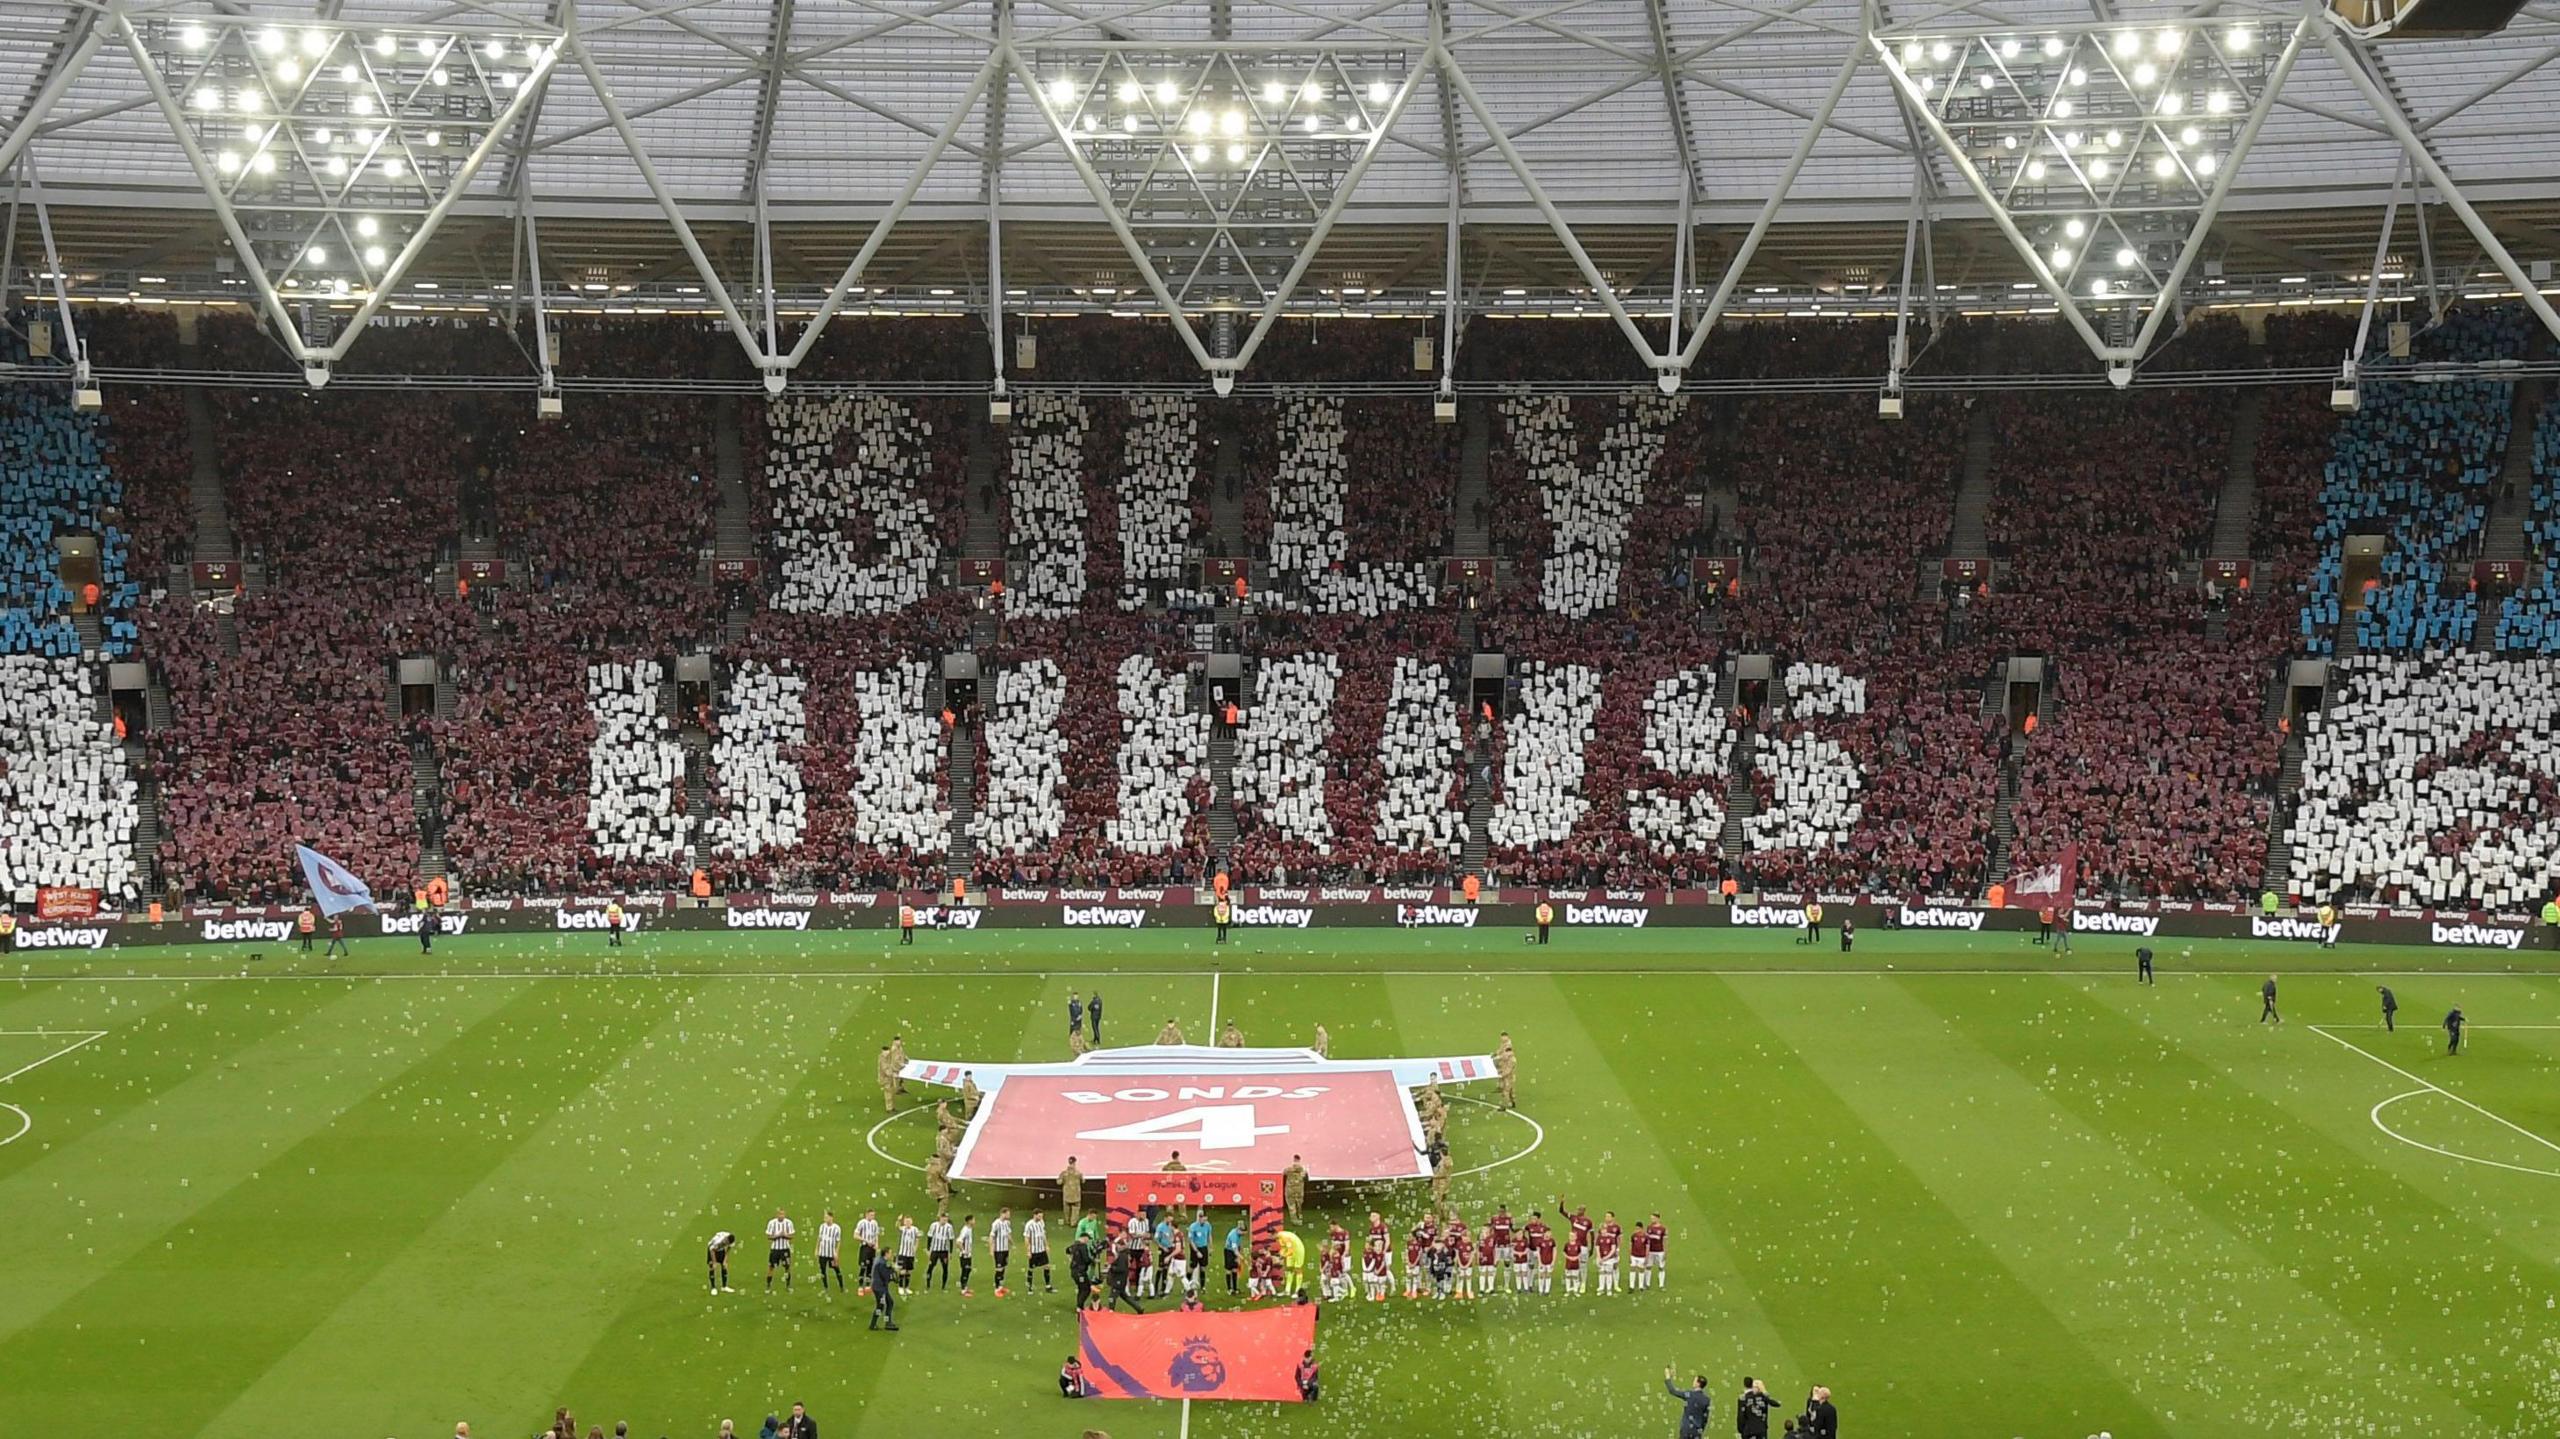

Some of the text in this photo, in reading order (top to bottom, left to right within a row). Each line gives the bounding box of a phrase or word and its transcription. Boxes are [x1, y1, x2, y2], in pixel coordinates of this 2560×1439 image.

[207, 564, 226, 573] 240
[472, 562, 490, 571] 239
[727, 561, 744, 570] 238
[974, 561, 991, 570] 237
[1218, 560, 1235, 569] 236
[1462, 560, 1479, 569] 235
[1707, 561, 1725, 569] 234
[1958, 561, 1976, 570] 233
[2218, 562, 2236, 571] 232
[2491, 562, 2510, 572] 231
[625, 895, 665, 906] betway
[771, 893, 818, 905] betway
[830, 892, 877, 905] betway
[1002, 888, 1049, 902] betway
[1060, 889, 1107, 902] betway
[1118, 889, 1164, 902] betway
[1259, 888, 1309, 902] betway
[1321, 888, 1371, 902] betway
[1383, 888, 1433, 902] betway
[1549, 890, 1588, 902] betway
[1763, 892, 1803, 904] betway
[1817, 893, 1857, 905] betway
[472, 899, 512, 910] betway
[523, 898, 565, 910] betway
[1924, 896, 1965, 907] betway
[2074, 899, 2106, 909] betway
[2160, 902, 2193, 912] betway
[2204, 903, 2236, 912] betway
[192, 907, 223, 917] betway
[236, 905, 266, 916] betway
[1063, 905, 1145, 928] betway
[1231, 904, 1312, 928] betway
[1566, 904, 1648, 928] betway
[2344, 907, 2378, 918] betway
[2389, 908, 2423, 919] betway
[2435, 910, 2469, 921] betway
[727, 907, 810, 930] betway
[1900, 905, 1985, 931] betway
[2073, 910, 2159, 936] betway
[2497, 913, 2532, 924] betway
[204, 919, 293, 941] betway
[382, 914, 468, 935] betay
[16, 927, 108, 948] betway
[2432, 922, 2525, 949] betway
[1060, 1086, 1331, 1103] BONDS
[1075, 1103, 1290, 1150] 4
[1204, 1181, 1238, 1191] League
